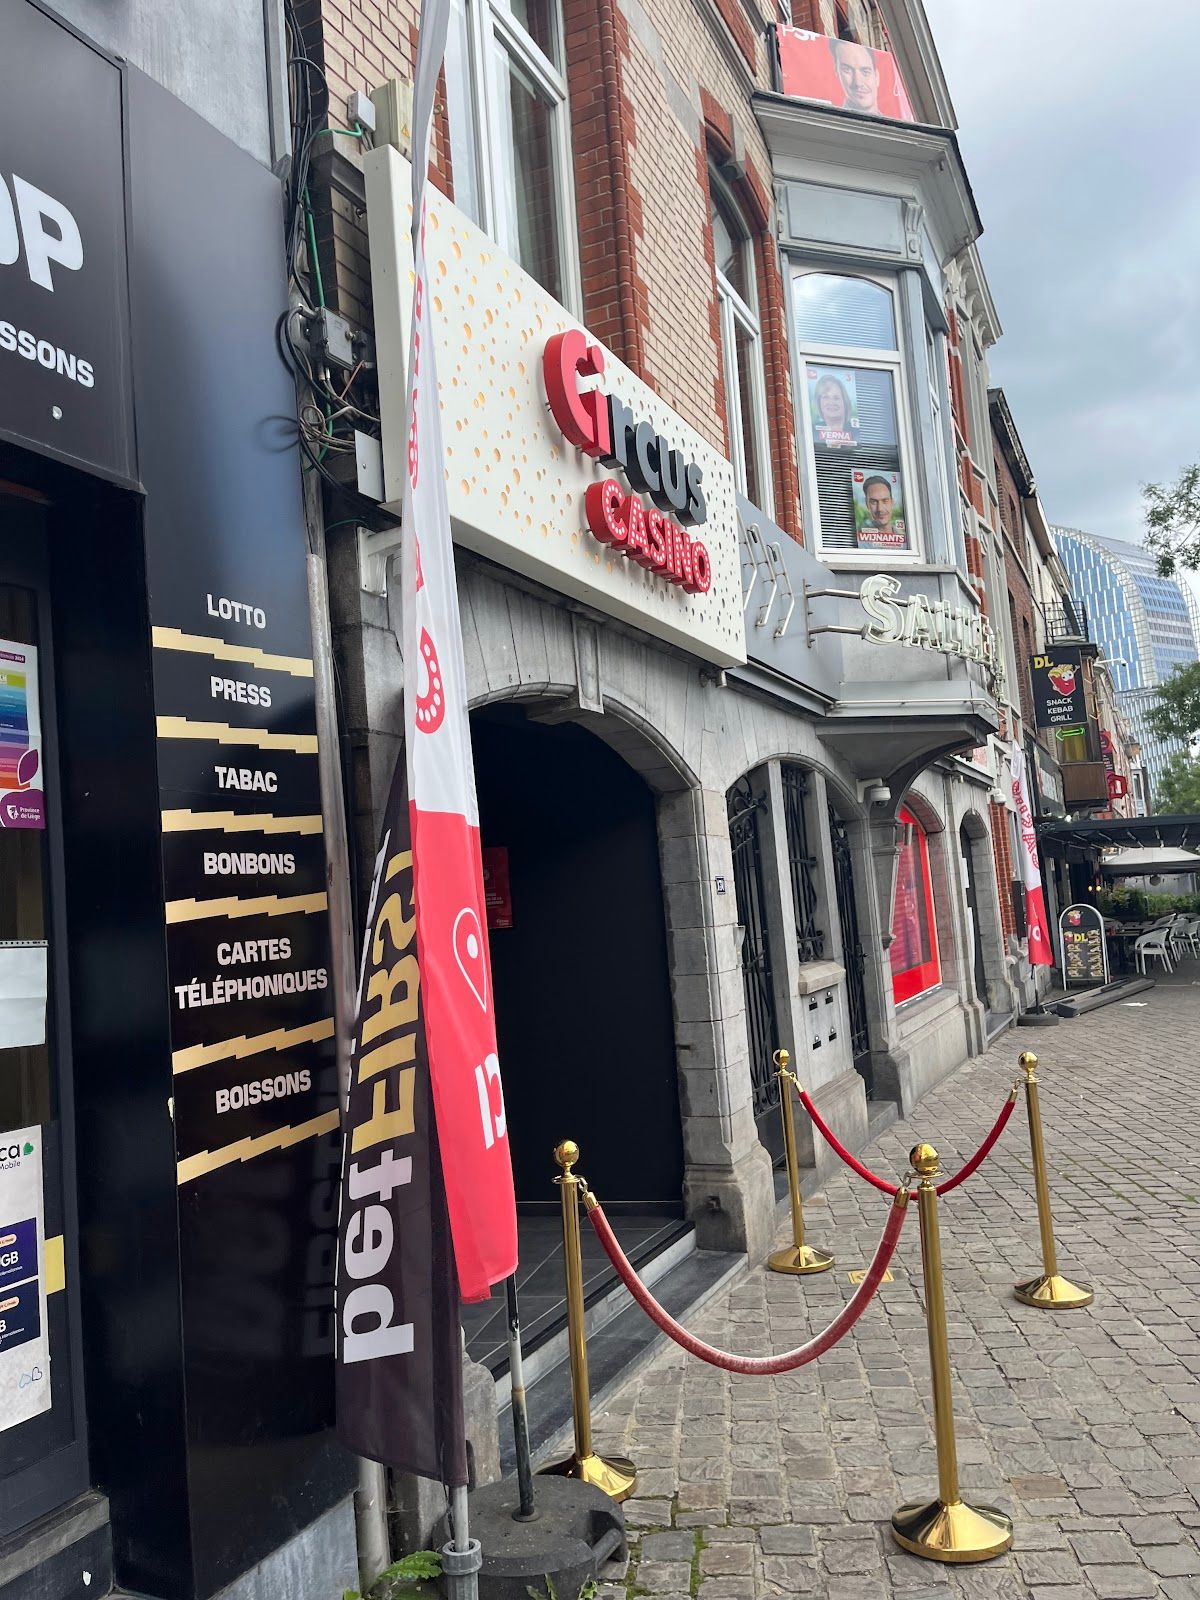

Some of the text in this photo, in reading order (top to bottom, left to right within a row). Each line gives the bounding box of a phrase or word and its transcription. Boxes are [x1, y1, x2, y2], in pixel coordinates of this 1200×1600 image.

[820, 431, 851, 440] YERNA
[584, 478, 712, 594] CASINO
[206, 594, 267, 629] LOTTO
[1033, 656, 1054, 669] DL
[210, 676, 272, 708] PRESS
[1046, 697, 1073, 707] SNACK
[1047, 705, 1074, 715] KEBAB
[1050, 714, 1073, 723] GRILL
[214, 766, 278, 793] TABAC
[203, 852, 296, 875] BONBONS
[1073, 933, 1089, 943] DL
[216, 937, 292, 966] CARTES
[174, 967, 328, 1010] TÉLÉPHONIQUES
[215, 1070, 312, 1114] BOISSONS
